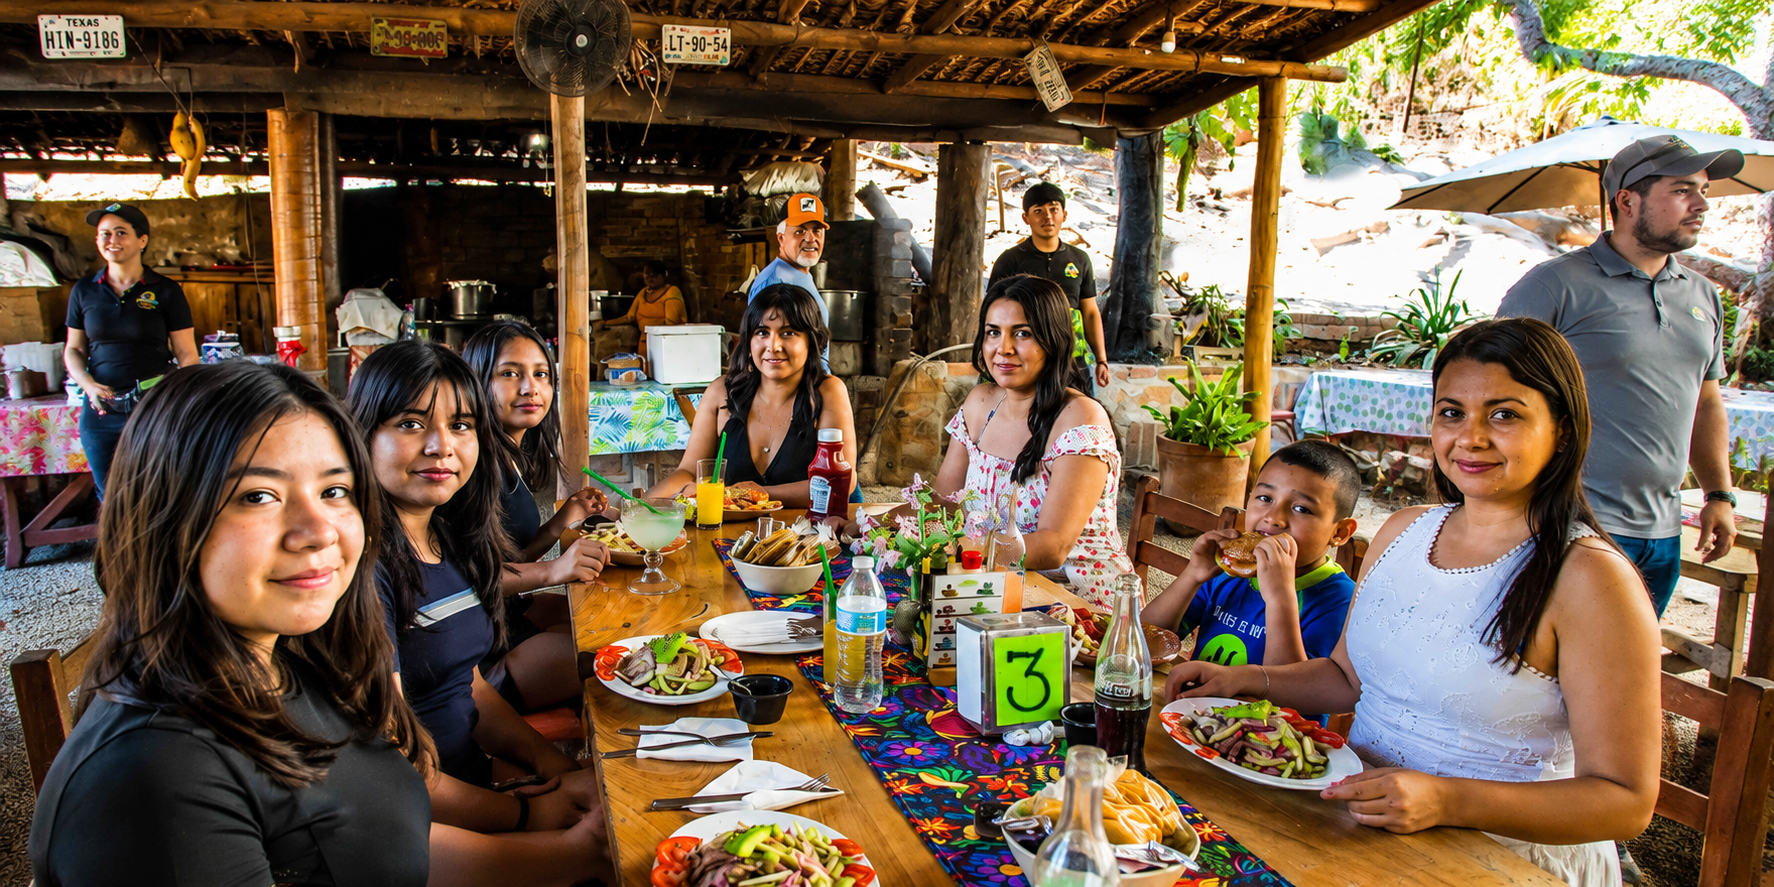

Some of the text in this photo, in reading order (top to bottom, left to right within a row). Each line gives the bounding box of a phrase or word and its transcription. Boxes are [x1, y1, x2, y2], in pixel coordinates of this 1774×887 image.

[66, 18, 100, 27] TEXAS
[45, 30, 119, 49] HIN-9186
[669, 35, 728, 52] LT-90-54
[1006, 647, 1051, 712] 3
